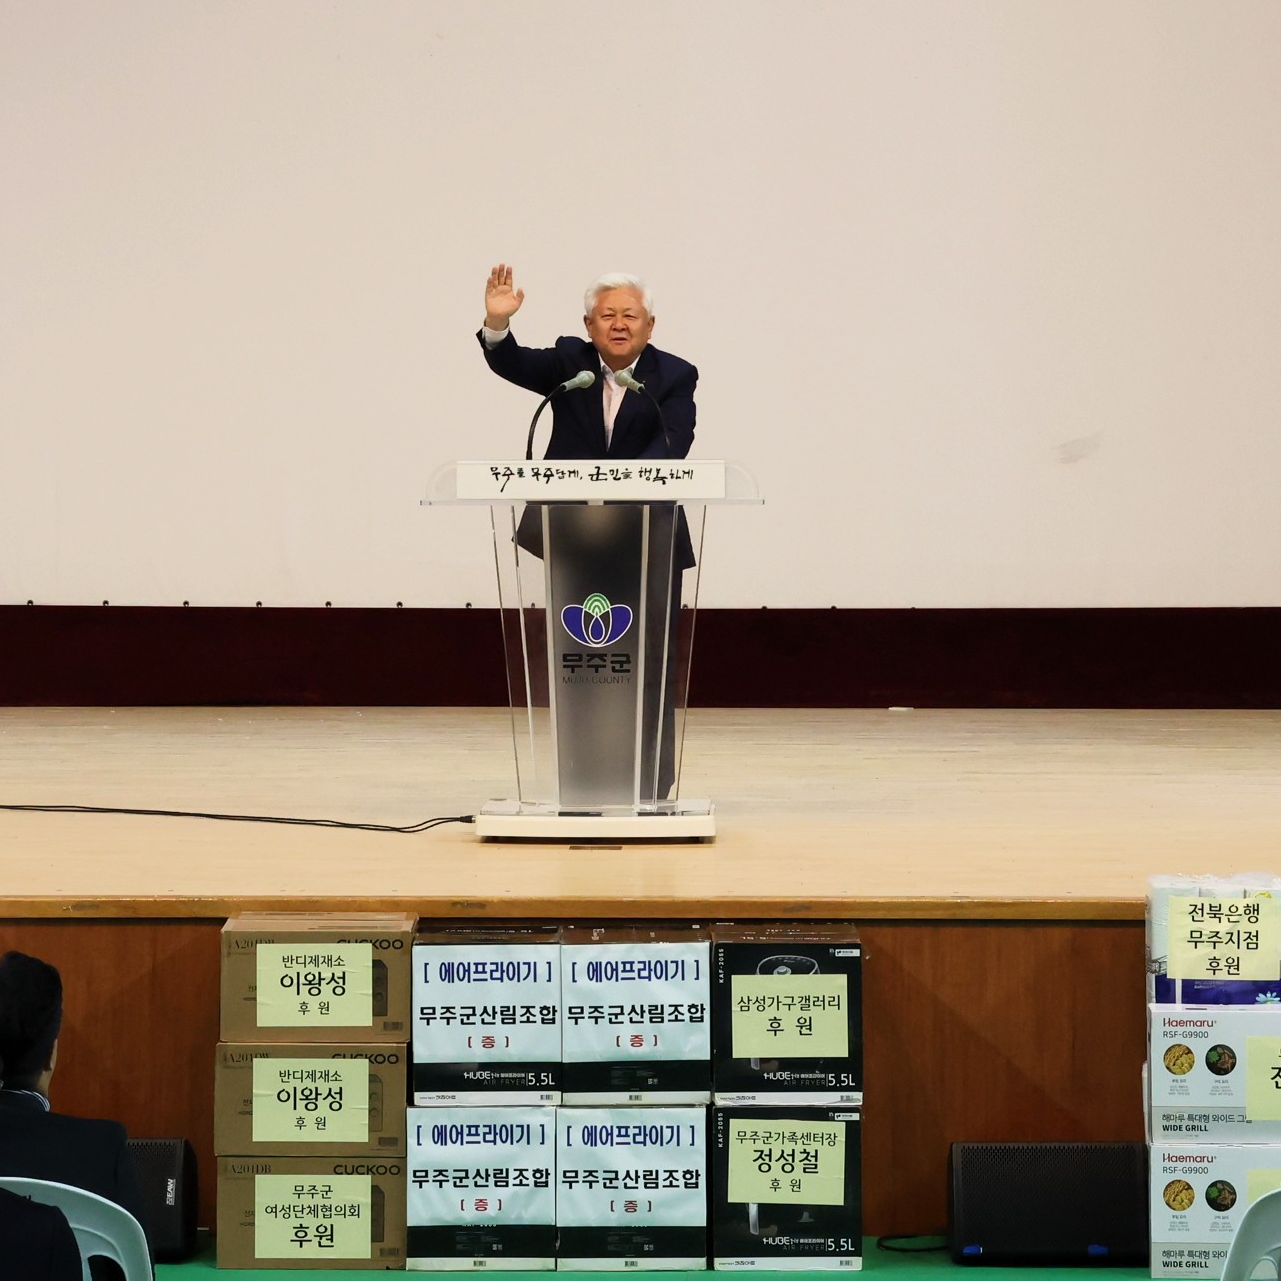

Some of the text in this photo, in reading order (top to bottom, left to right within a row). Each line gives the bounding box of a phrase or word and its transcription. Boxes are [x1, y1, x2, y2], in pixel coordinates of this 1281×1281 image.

[638, 466, 694, 486] 행복하게
[562, 652, 632, 674] 무주군
[1187, 902, 1260, 924] 전북은행
[1186, 929, 1259, 951] 무주지점
[282, 954, 346, 969] 반디제재소
[1205, 955, 1240, 976] 후원
[280, 970, 346, 997] 이왕성
[737, 994, 841, 1013] 삼성가구갤러리
[419, 1004, 558, 1026] 무주군산림조합
[567, 1003, 706, 1026] 무주군산림조합
[1162, 1017, 1214, 1028] Haemaru
[1162, 1030, 1209, 1039] RSF-G9900
[1162, 1124, 1209, 1132] WIDE GRILL
[735, 1130, 838, 1148] 무주군가족센터장
[333, 1165, 400, 1176] CUCKOO
[752, 1147, 819, 1174] 정성철
[292, 1184, 334, 1200] 무주군
[264, 1203, 361, 1220] 여성단체협의회
[289, 1223, 335, 1249] 후원
